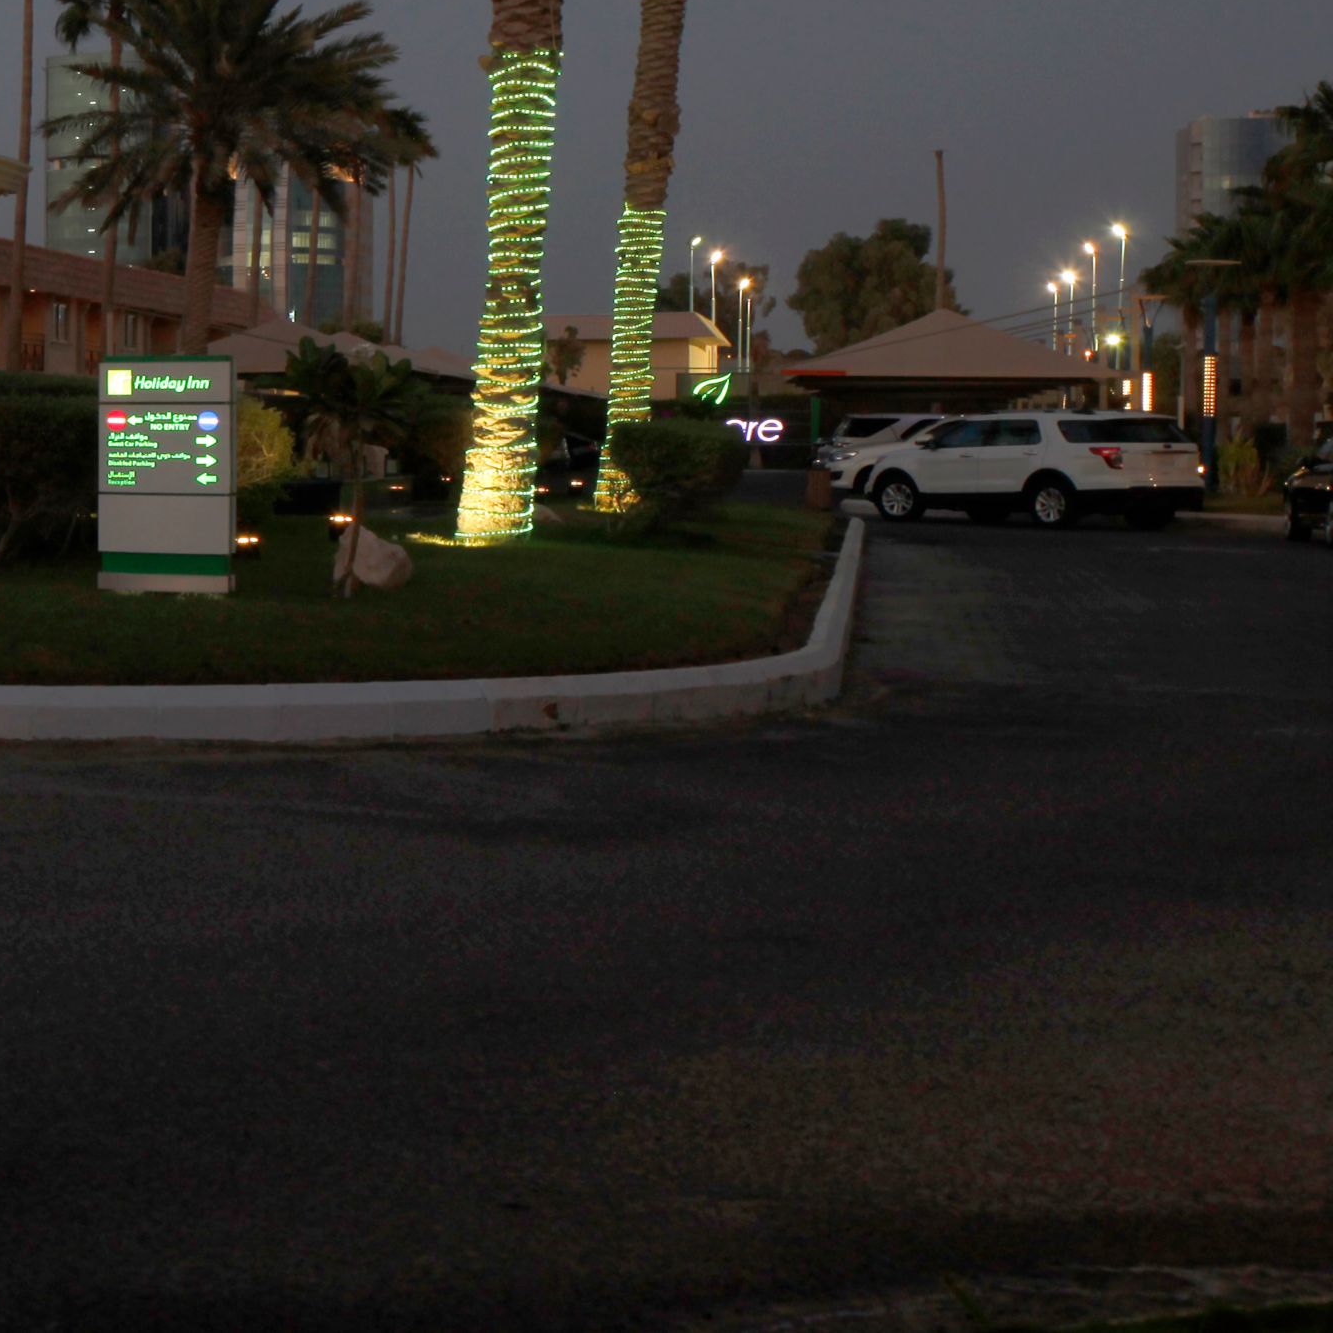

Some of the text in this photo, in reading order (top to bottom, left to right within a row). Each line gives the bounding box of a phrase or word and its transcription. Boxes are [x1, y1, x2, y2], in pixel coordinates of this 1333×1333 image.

[134, 375, 210, 393] Holiday Inn
[150, 423, 190, 431] NO ENTRY
